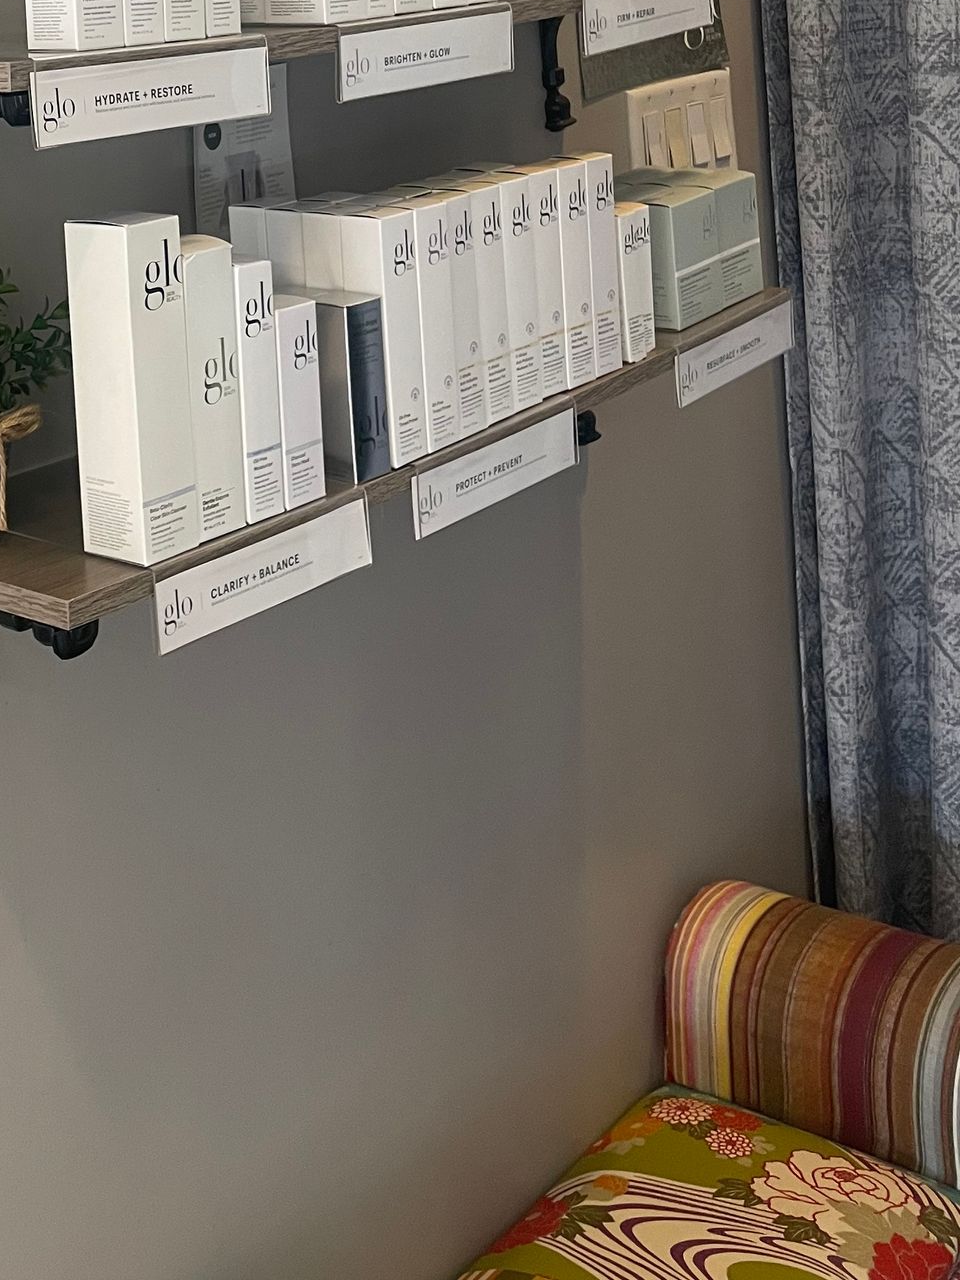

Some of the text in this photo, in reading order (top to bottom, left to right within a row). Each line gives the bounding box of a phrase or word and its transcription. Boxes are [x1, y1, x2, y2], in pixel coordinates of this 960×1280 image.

[589, 8, 607, 43] glo
[617, 12, 631, 24] FIRM
[636, 7, 655, 20] REPAIR
[346, 47, 370, 88] glo
[384, 51, 422, 67] BRIGHTEN
[429, 47, 451, 59] GLOW
[43, 87, 76, 133] glo
[94, 90, 140, 107] HYDRATE
[151, 83, 193, 99] RESTORE
[706, 348, 736, 370] RESURFACE
[358, 395, 387, 458] gl
[455, 470, 486, 493] PROTECT
[493, 454, 523, 476] PREVENT
[420, 484, 443, 525] glo
[210, 574, 250, 599] CLARIFY
[259, 553, 301, 580] BALANCE
[164, 589, 193, 637] glo
